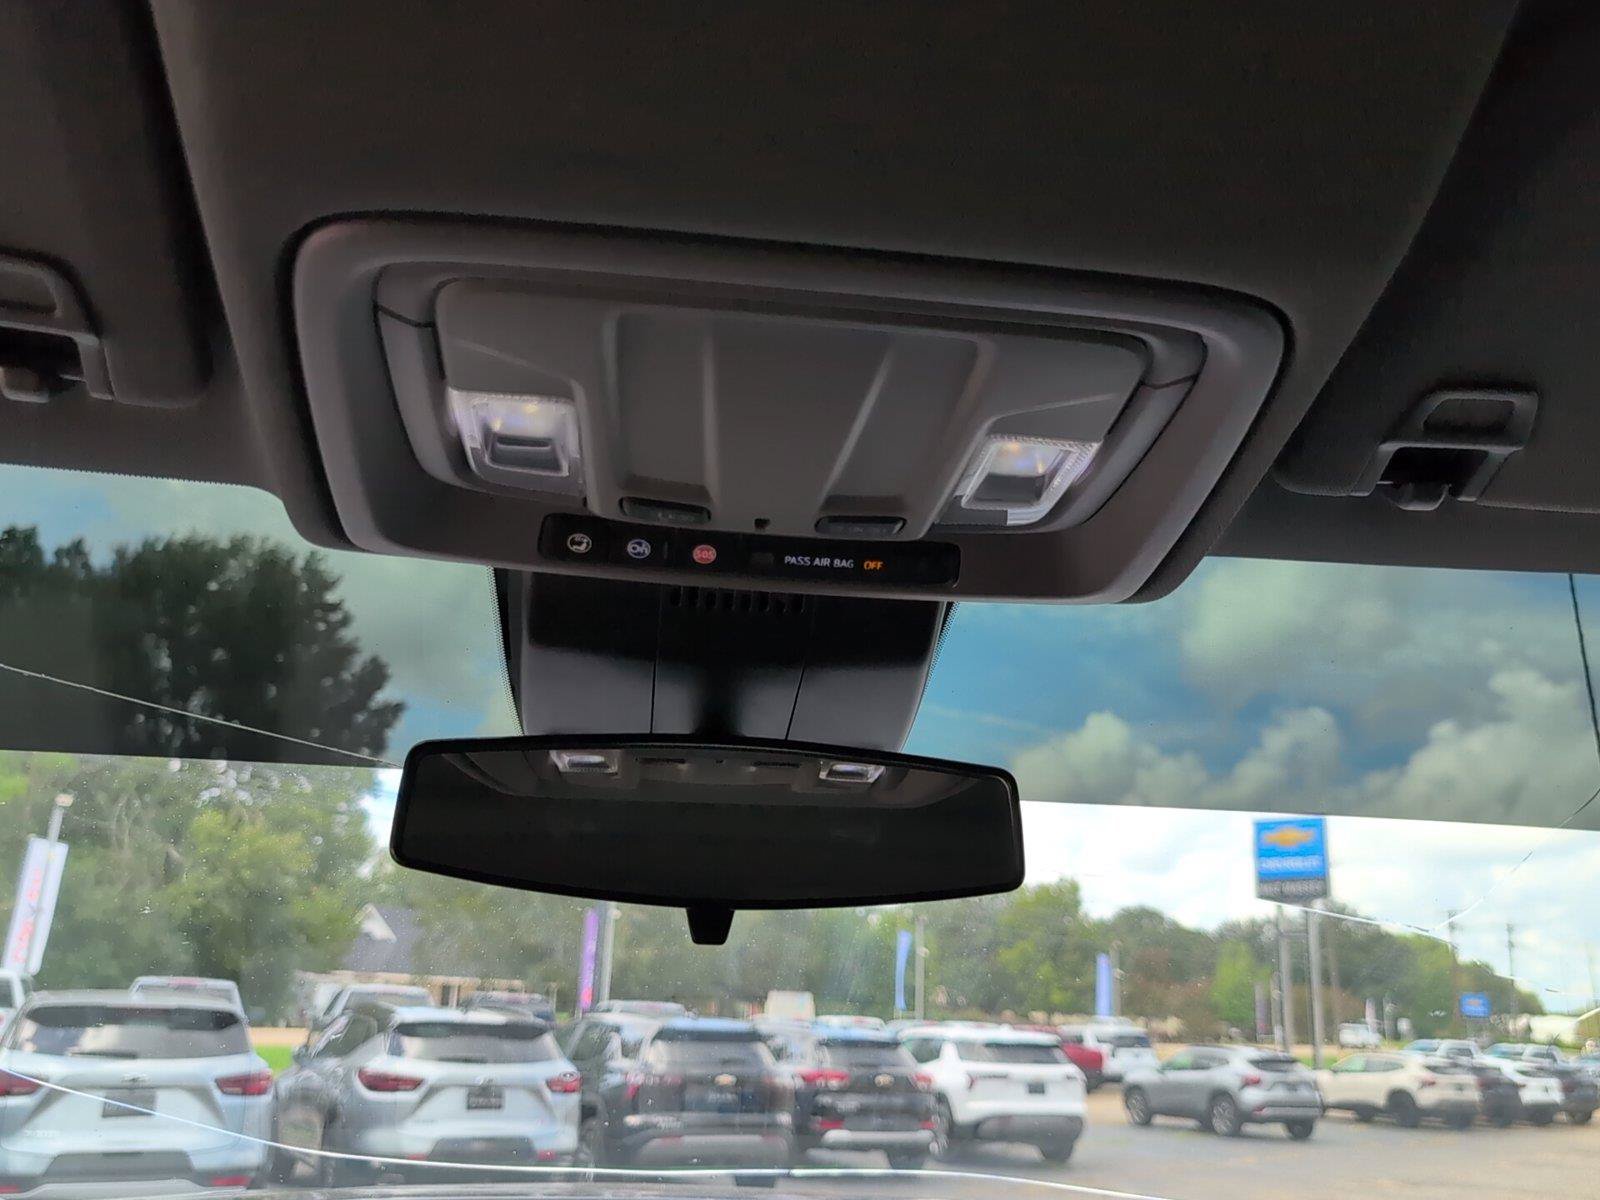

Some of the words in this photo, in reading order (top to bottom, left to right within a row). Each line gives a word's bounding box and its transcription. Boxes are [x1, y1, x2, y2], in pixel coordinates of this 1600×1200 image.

[784, 555, 811, 566] PASS
[813, 557, 830, 567] AIR
[833, 558, 854, 569] BAG
[863, 560, 884, 570] OFF
